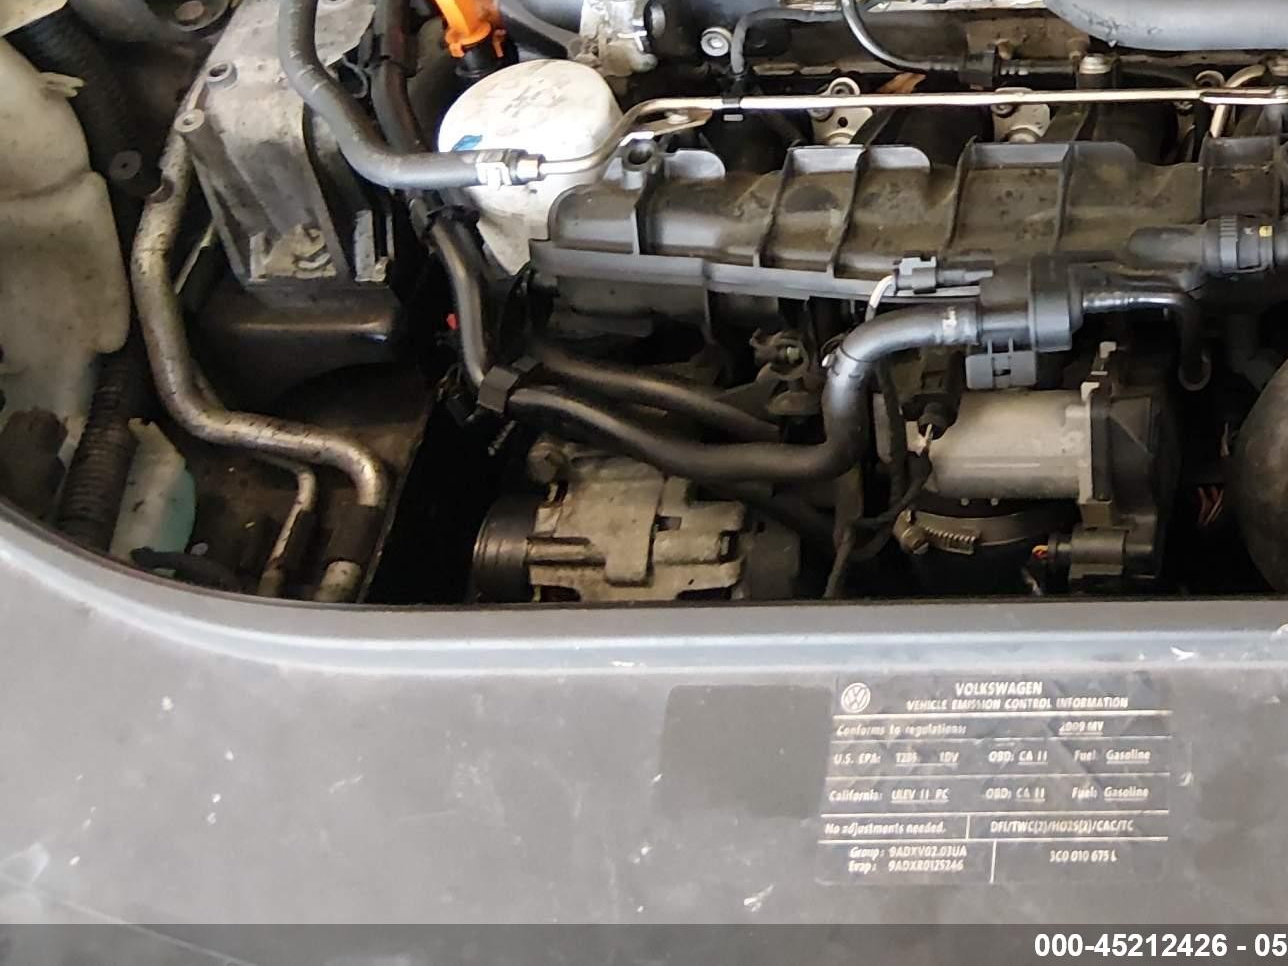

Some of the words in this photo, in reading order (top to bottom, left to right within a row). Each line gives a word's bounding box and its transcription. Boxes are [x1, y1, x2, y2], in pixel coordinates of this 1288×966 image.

[955, 682, 1043, 696] VOLKSWAGEN
[906, 700, 948, 711] VEHICLE
[951, 699, 1001, 711] EMISSION
[1004, 698, 1052, 710] CONTROL
[1056, 696, 1129, 709] INFORMATION
[836, 724, 886, 736] Conforms
[889, 724, 901, 735] to
[834, 753, 854, 765] U.S.
[988, 750, 1014, 763] OBD:
[1018, 750, 1034, 762] CA
[1105, 749, 1151, 761] Gasoline
[1015, 787, 1030, 799] CA
[1103, 786, 1149, 799] Gasoline
[824, 823, 840, 834] No
[842, 822, 904, 836] adjustments
[906, 821, 946, 834] needed.
